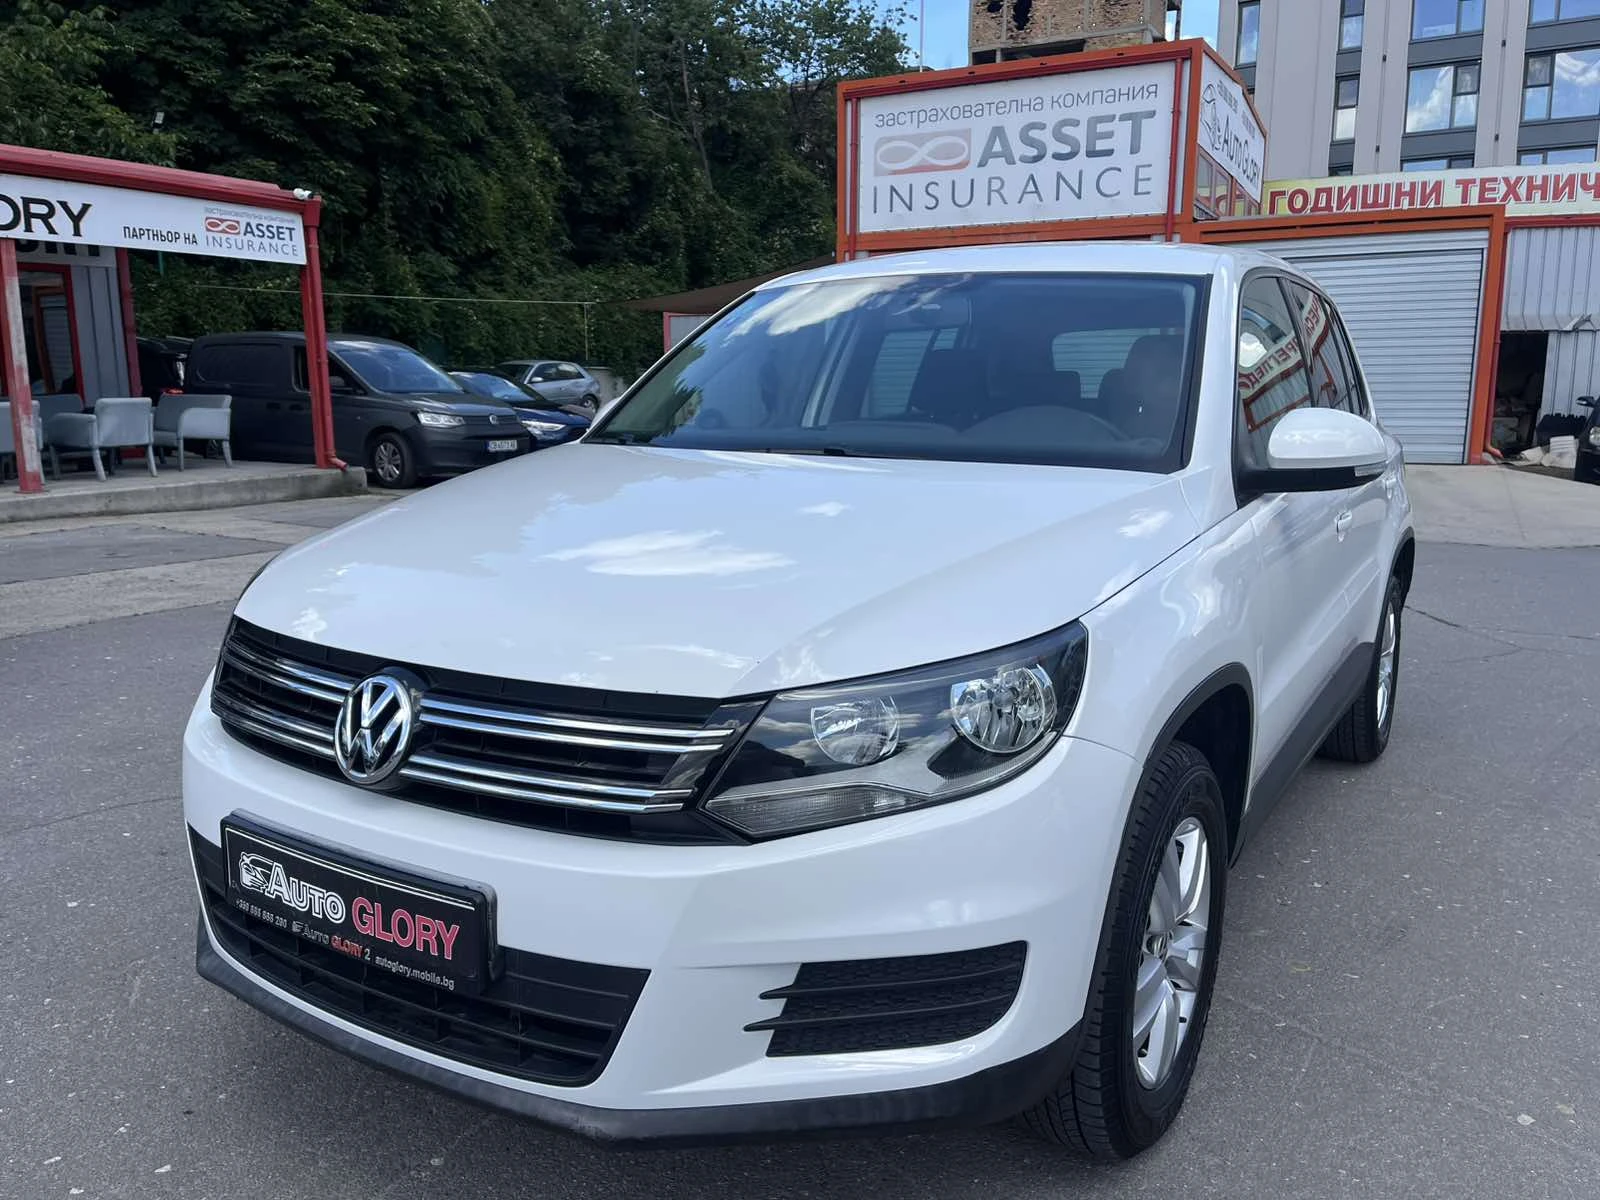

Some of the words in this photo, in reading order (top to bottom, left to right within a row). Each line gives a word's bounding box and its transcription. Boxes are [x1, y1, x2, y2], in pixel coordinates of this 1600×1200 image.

[874, 95, 1044, 129] застрахователна
[1050, 82, 1159, 110] компания
[976, 109, 1157, 168] ASSET
[872, 163, 1153, 214] INSURANCE
[1268, 179, 1446, 216] ГОДИШНИ
[1455, 171, 1600, 206] ТЕХНИЧ
[123, 225, 181, 244] ПАРТНЬОР
[184, 232, 198, 246] НА
[205, 235, 299, 257] INSURANCE
[243, 221, 296, 242] ASSET
[266, 861, 346, 924] AUTO
[351, 896, 460, 960] GLORY
[364, 948, 371, 961] 2
